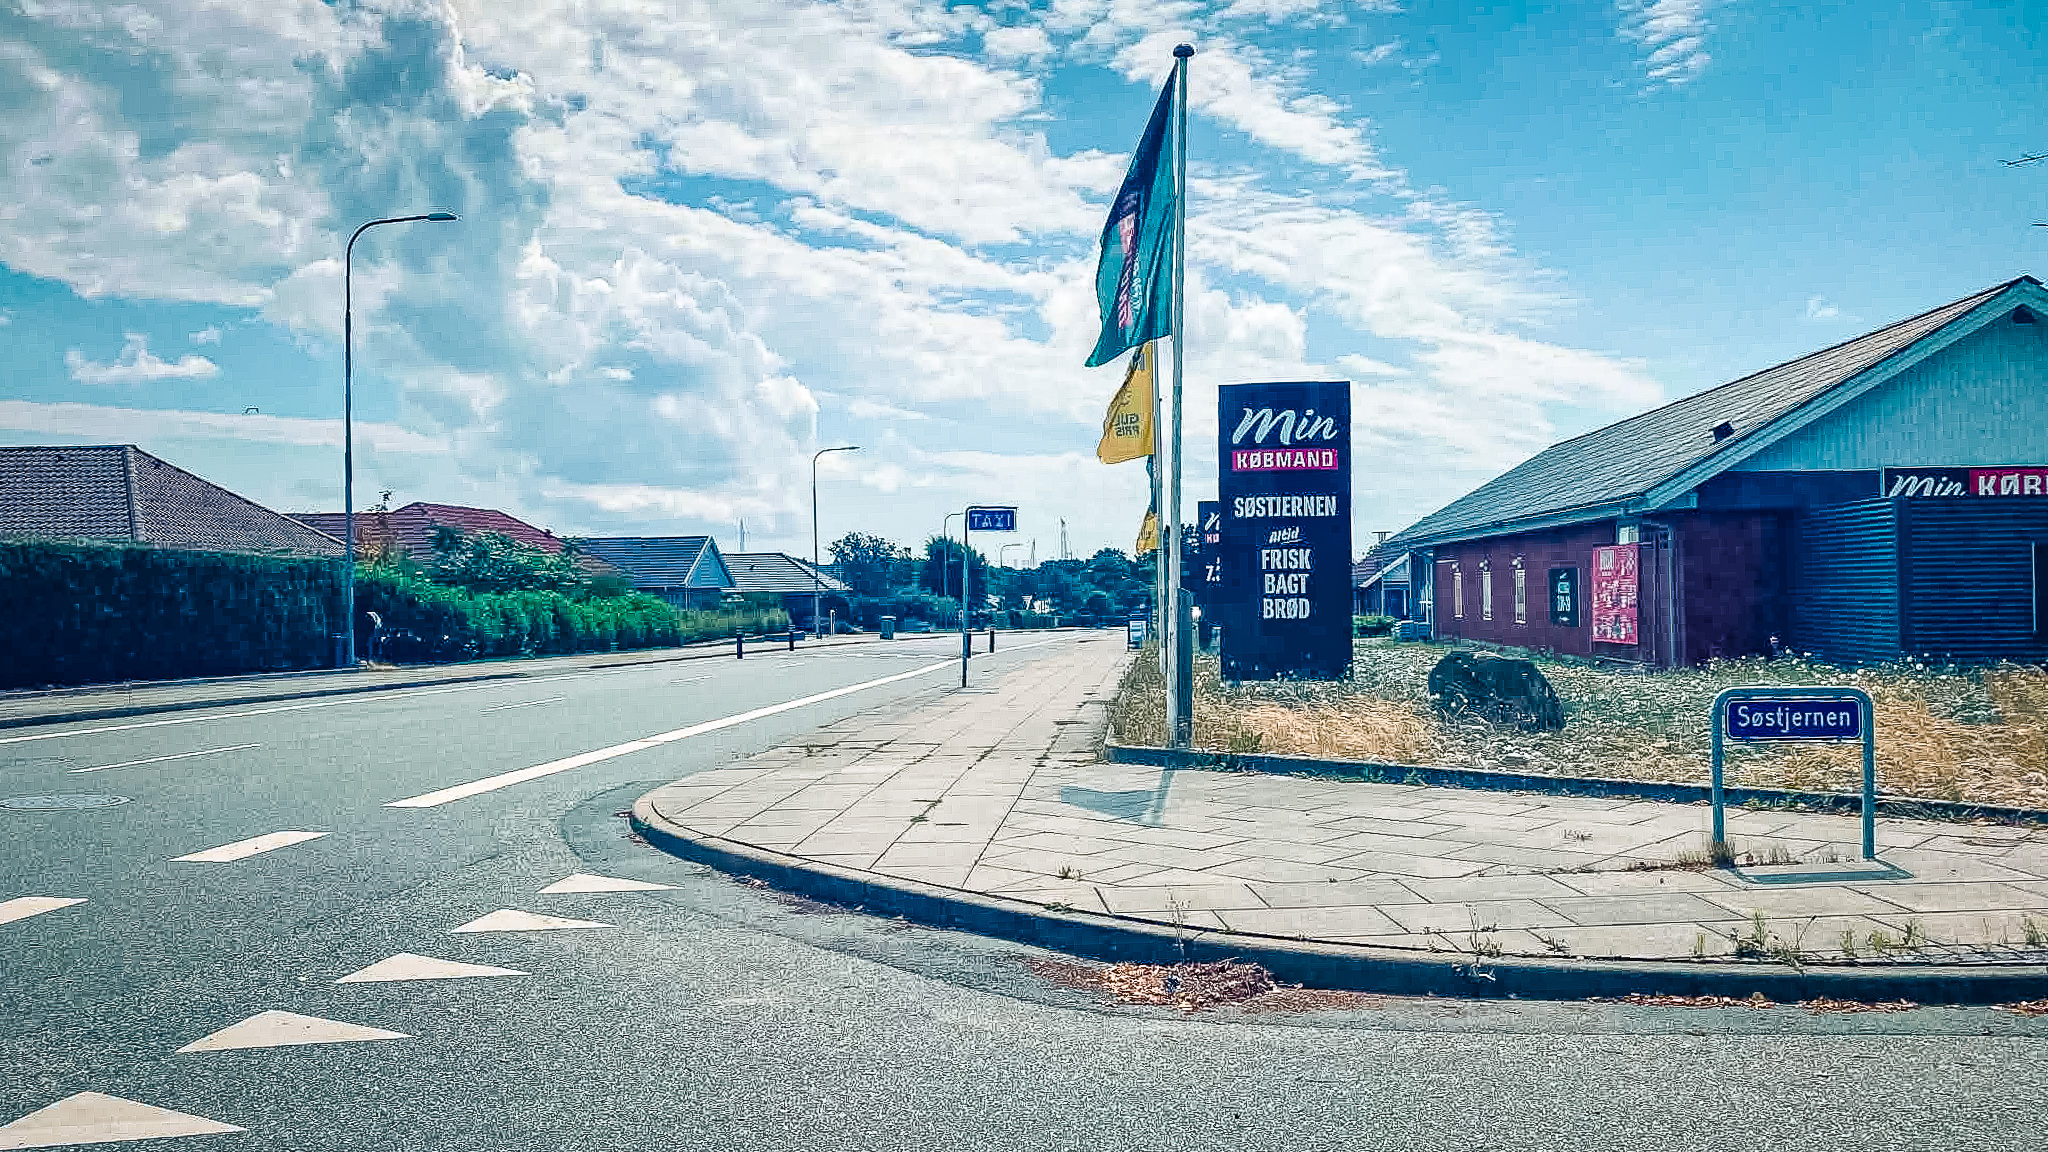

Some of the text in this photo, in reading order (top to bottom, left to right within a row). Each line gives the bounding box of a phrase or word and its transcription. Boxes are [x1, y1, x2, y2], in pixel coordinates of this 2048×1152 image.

[1232, 407, 1338, 445] Min
[1236, 450, 1334, 469] KØBMAND
[1889, 474, 1966, 497] Min
[1234, 495, 1337, 518] SØSTJERNEN
[971, 513, 1011, 528] TAXI
[1261, 548, 1312, 570] FRISK
[1264, 573, 1310, 595] BAGT
[1263, 598, 1311, 619] BRØD
[1737, 705, 1851, 734] Søstjernen
